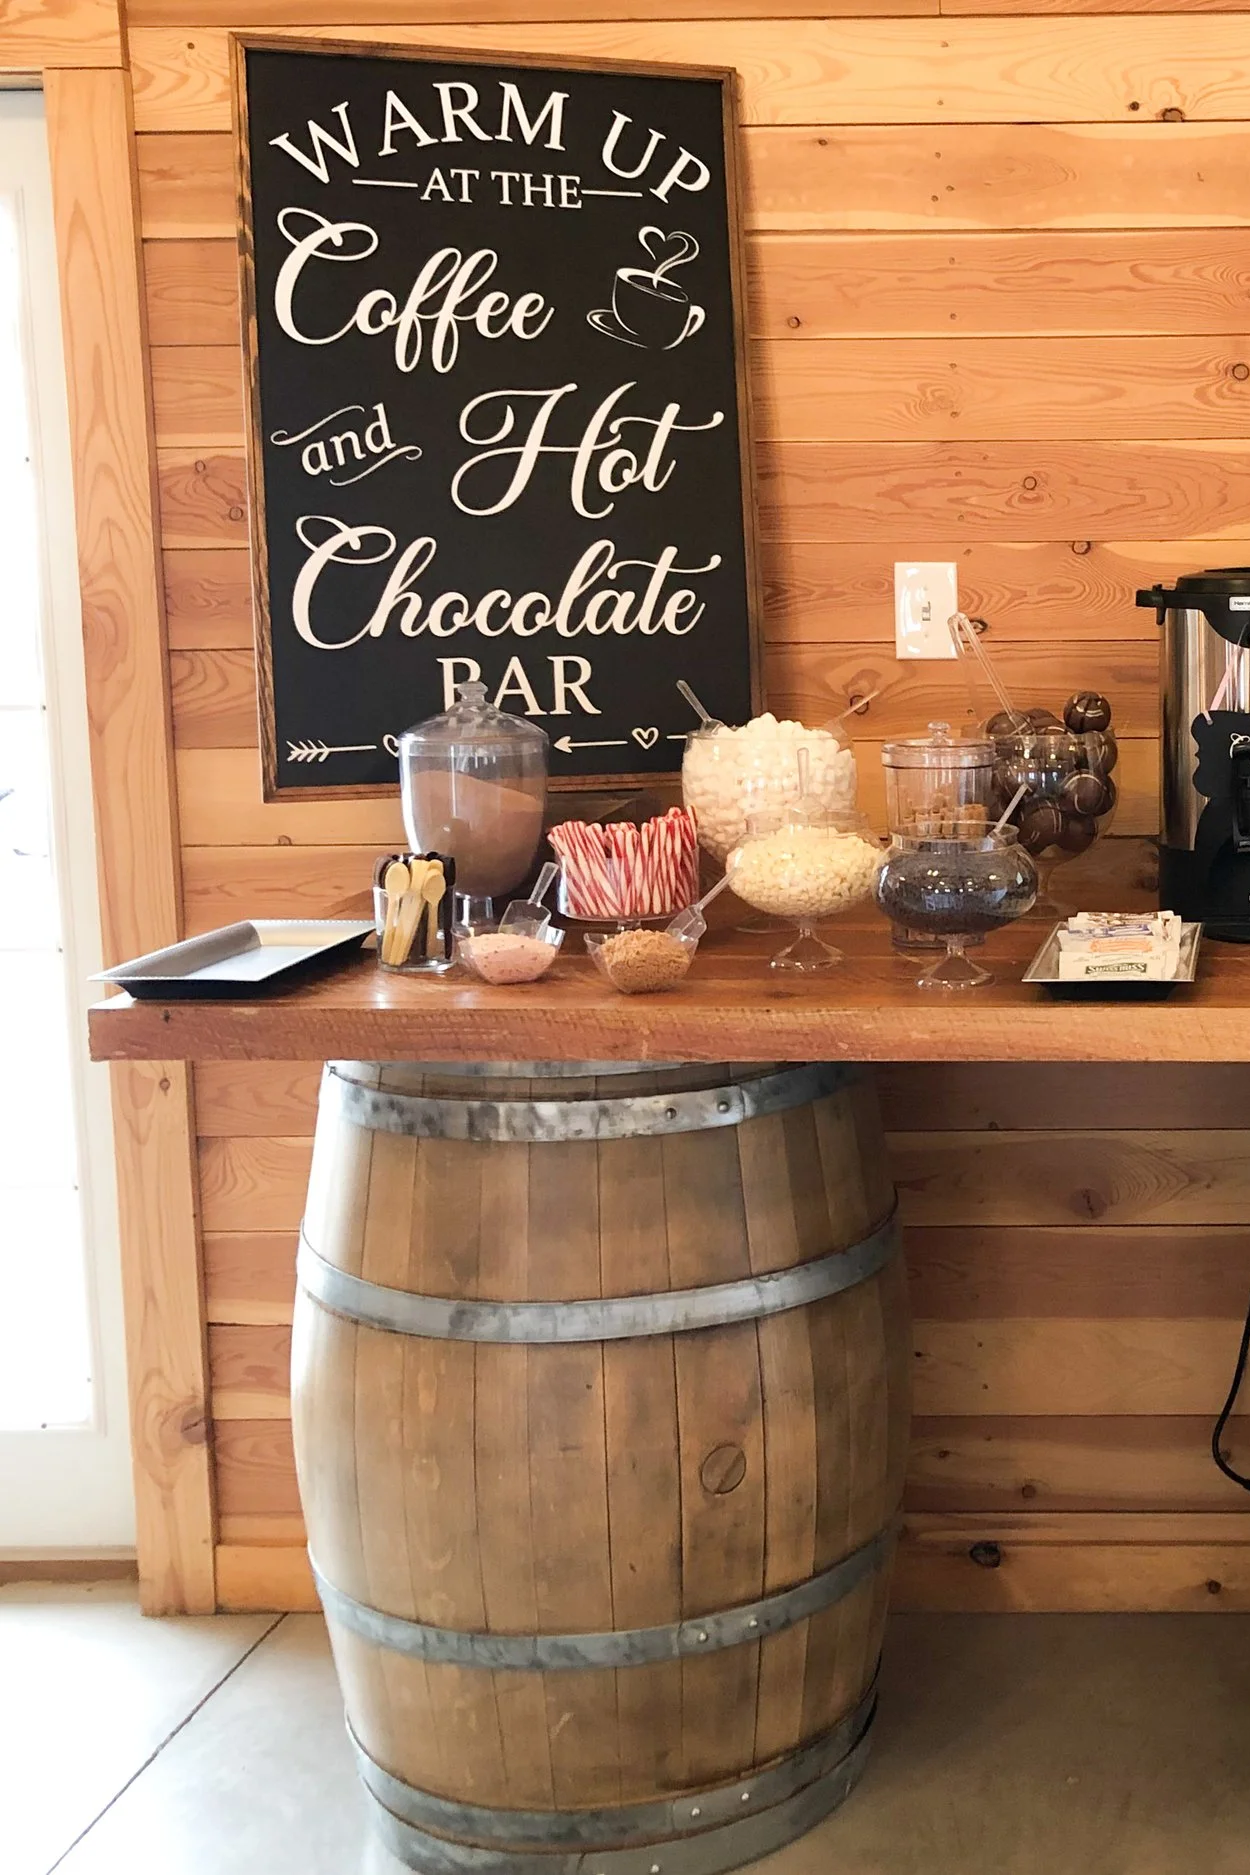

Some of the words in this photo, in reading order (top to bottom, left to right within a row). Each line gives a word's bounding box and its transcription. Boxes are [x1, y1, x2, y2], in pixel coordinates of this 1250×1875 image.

[269, 81, 570, 184] WARM
[602, 110, 711, 203] UP
[420, 168, 480, 202] AT
[491, 171, 583, 208] THE
[275, 207, 555, 373] Coffee
[301, 403, 398, 476] and
[451, 382, 725, 518] Hot
[292, 515, 722, 649] Chocolate
